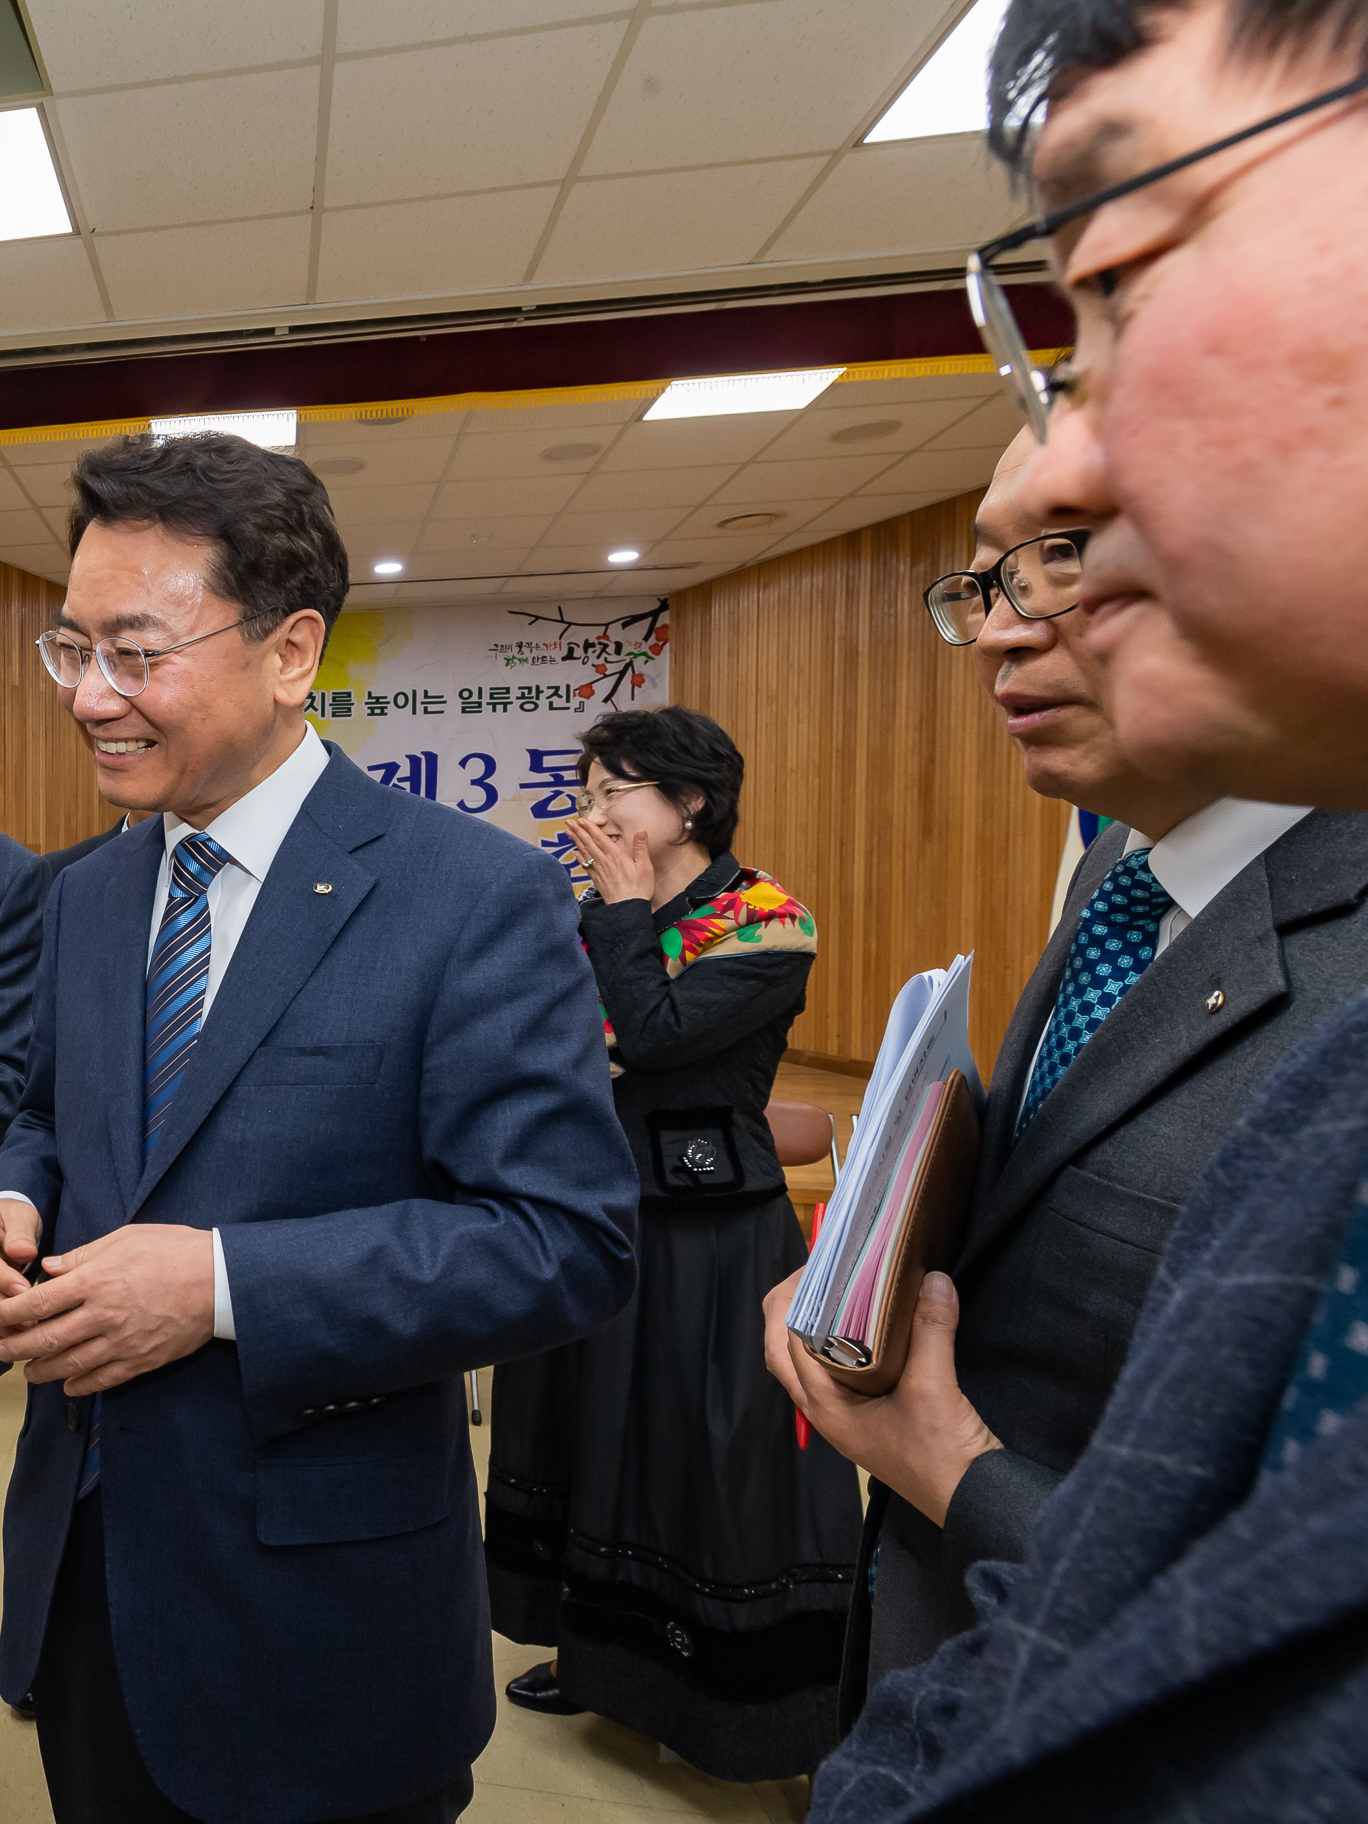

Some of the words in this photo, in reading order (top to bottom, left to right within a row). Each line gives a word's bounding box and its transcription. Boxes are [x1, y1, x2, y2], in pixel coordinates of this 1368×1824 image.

[543, 640, 562, 652] 가치
[561, 638, 627, 666] 광진
[503, 655, 529, 670] 함께
[531, 655, 559, 667] 만드는
[364, 689, 448, 717] 높이는
